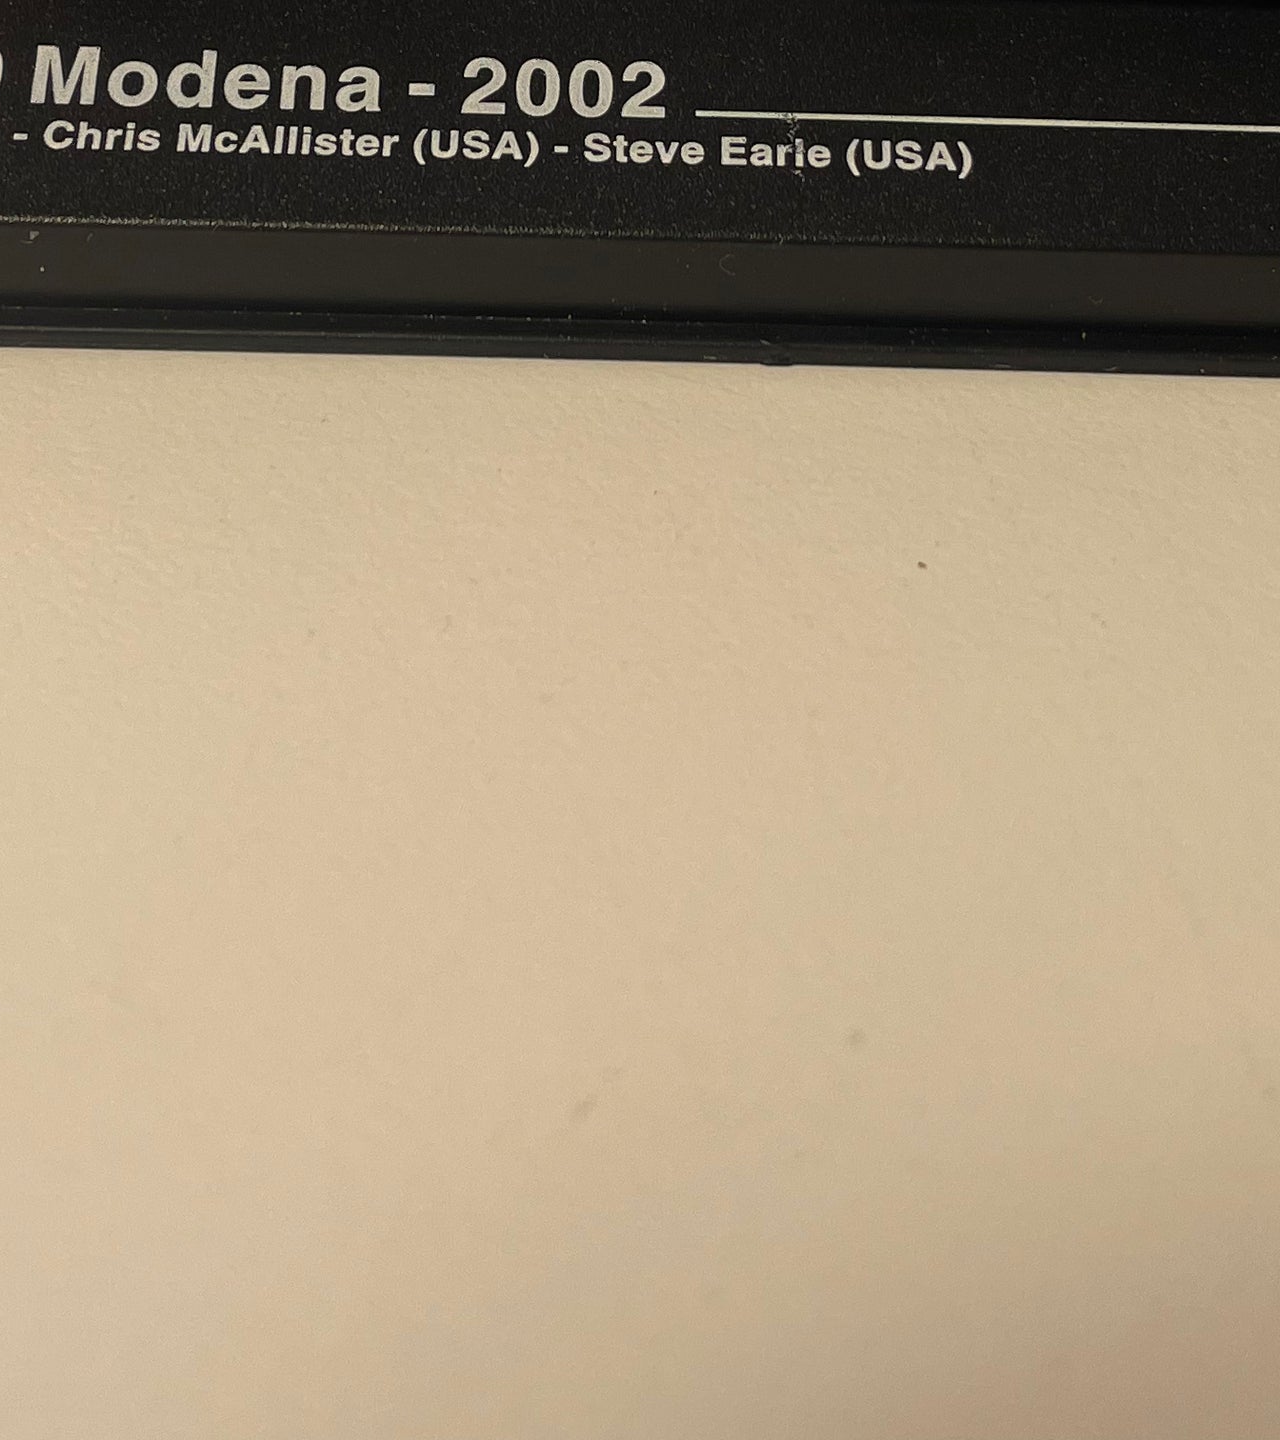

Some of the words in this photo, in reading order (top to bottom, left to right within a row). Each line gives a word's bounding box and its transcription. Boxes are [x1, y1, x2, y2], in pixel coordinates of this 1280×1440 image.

[30, 45, 380, 112] Modena
[408, 83, 436, 95] -
[462, 58, 666, 118] 2002
[43, 120, 160, 152] Chris
[175, 123, 399, 160] McAllister
[412, 128, 540, 166] (USA)
[583, 133, 705, 165] Steve
[845, 139, 973, 179] (USA)
